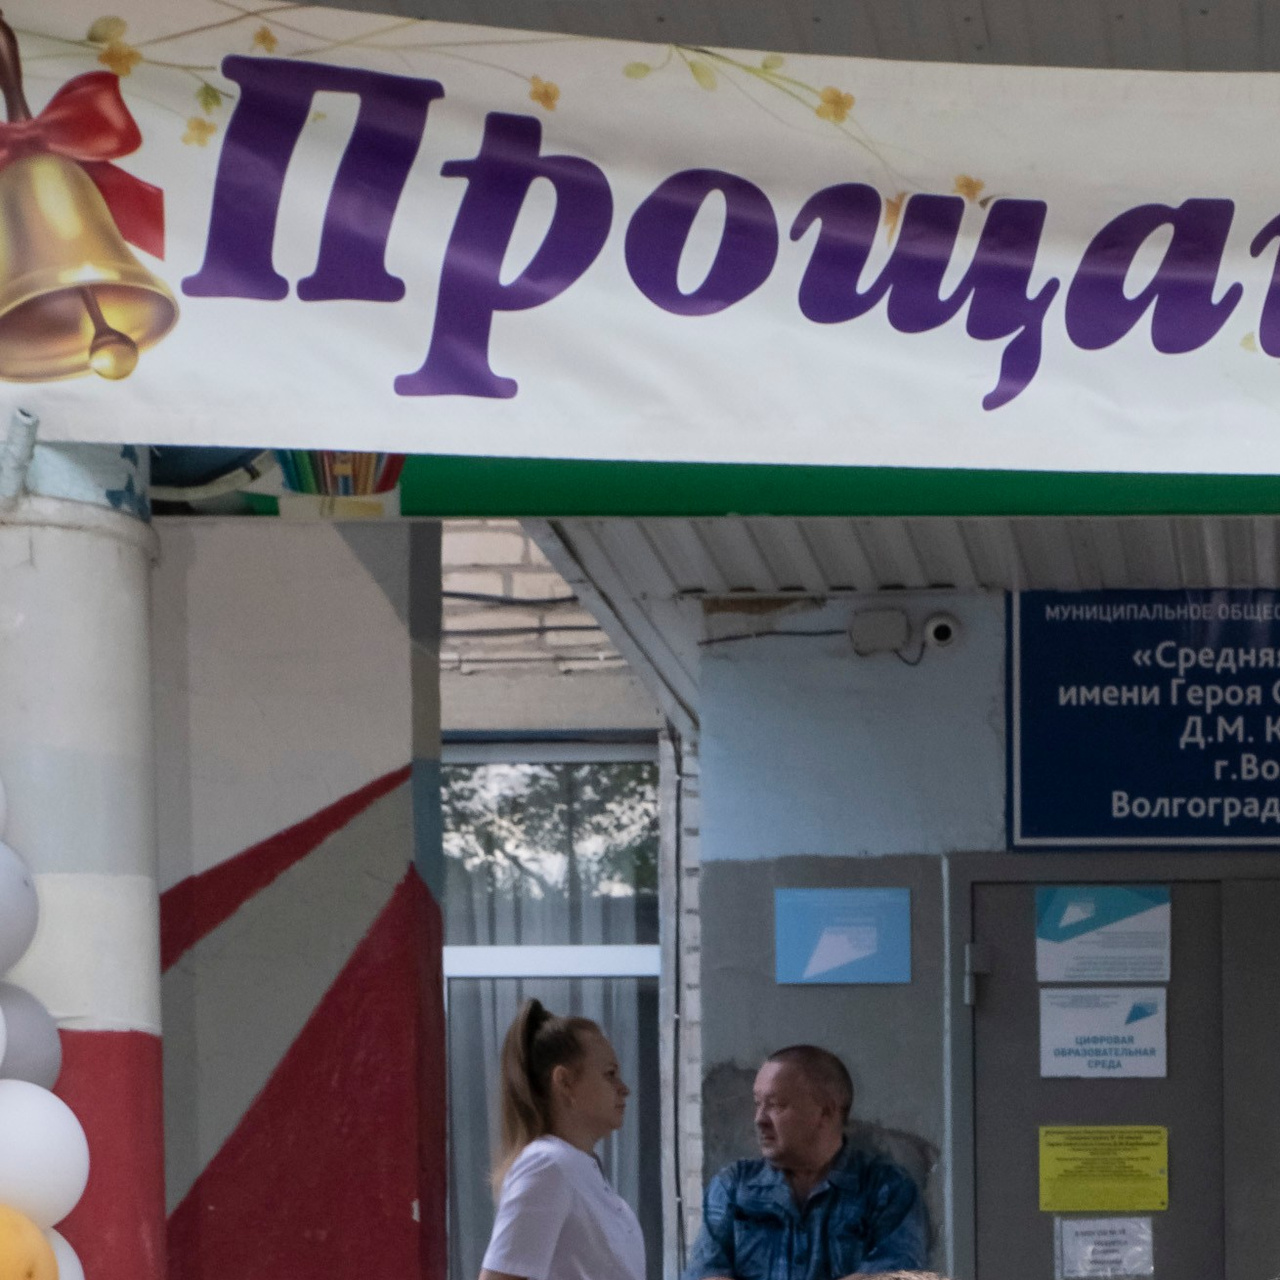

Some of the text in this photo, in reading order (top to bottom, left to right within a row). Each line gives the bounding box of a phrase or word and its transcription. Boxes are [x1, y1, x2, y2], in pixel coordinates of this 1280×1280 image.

[1045, 602, 1213, 622] МУНИЦИПАЛЬНОЕ
[1058, 685, 1160, 706] имени
[1170, 679, 1262, 712] Героя
[1179, 716, 1254, 750] Д.М.
[1075, 1035, 1135, 1046] ЦИФРОВАЯ
[1053, 1048, 1157, 1057] ОБРАЗОВАТЕЛЬНАЯ
[1087, 1059, 1122, 1069] СРЕДА
